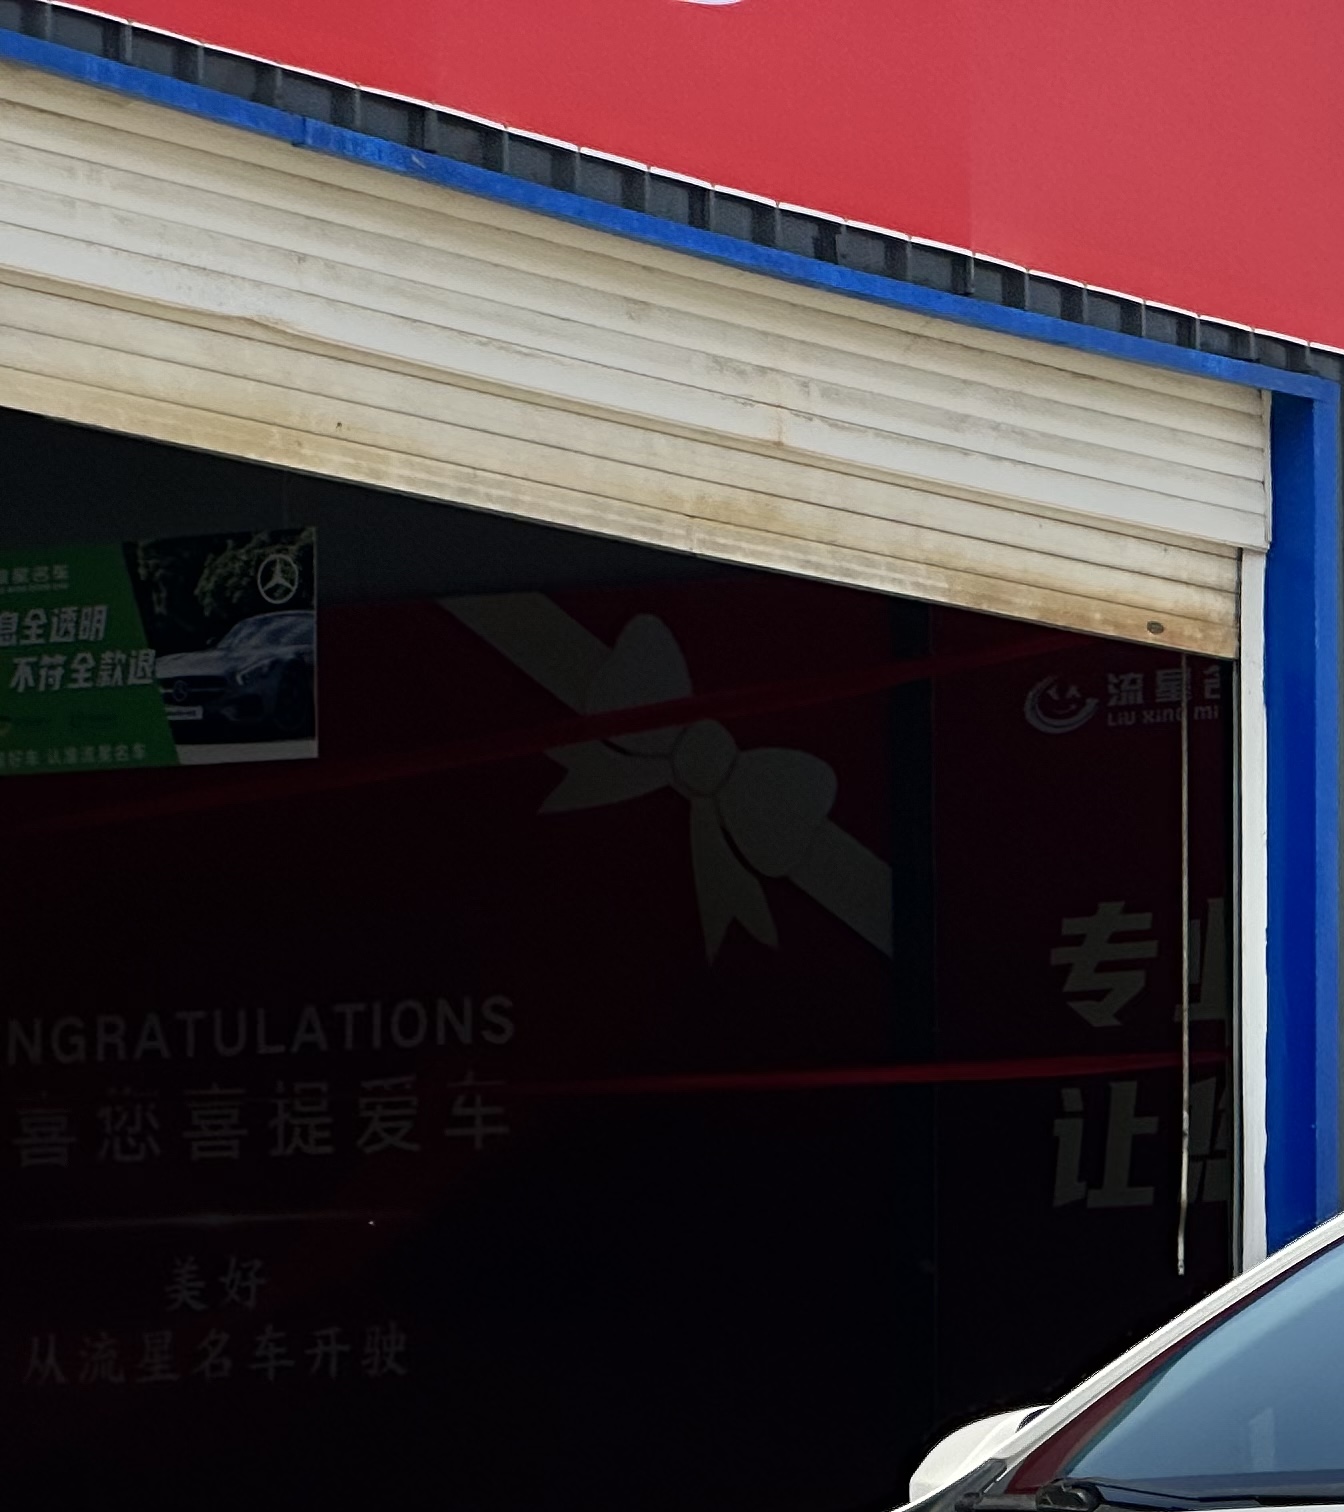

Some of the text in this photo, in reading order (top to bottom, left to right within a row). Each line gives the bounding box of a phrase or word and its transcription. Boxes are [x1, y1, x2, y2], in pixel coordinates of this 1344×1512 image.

[9, 648, 156, 693] 不符全款退
[8, 993, 517, 1067] NGRATULATIONS
[12, 1069, 512, 1169] 喜您喜提爱车
[164, 1255, 268, 1313] 美好
[23, 1321, 409, 1385] 从流星名车开驶
